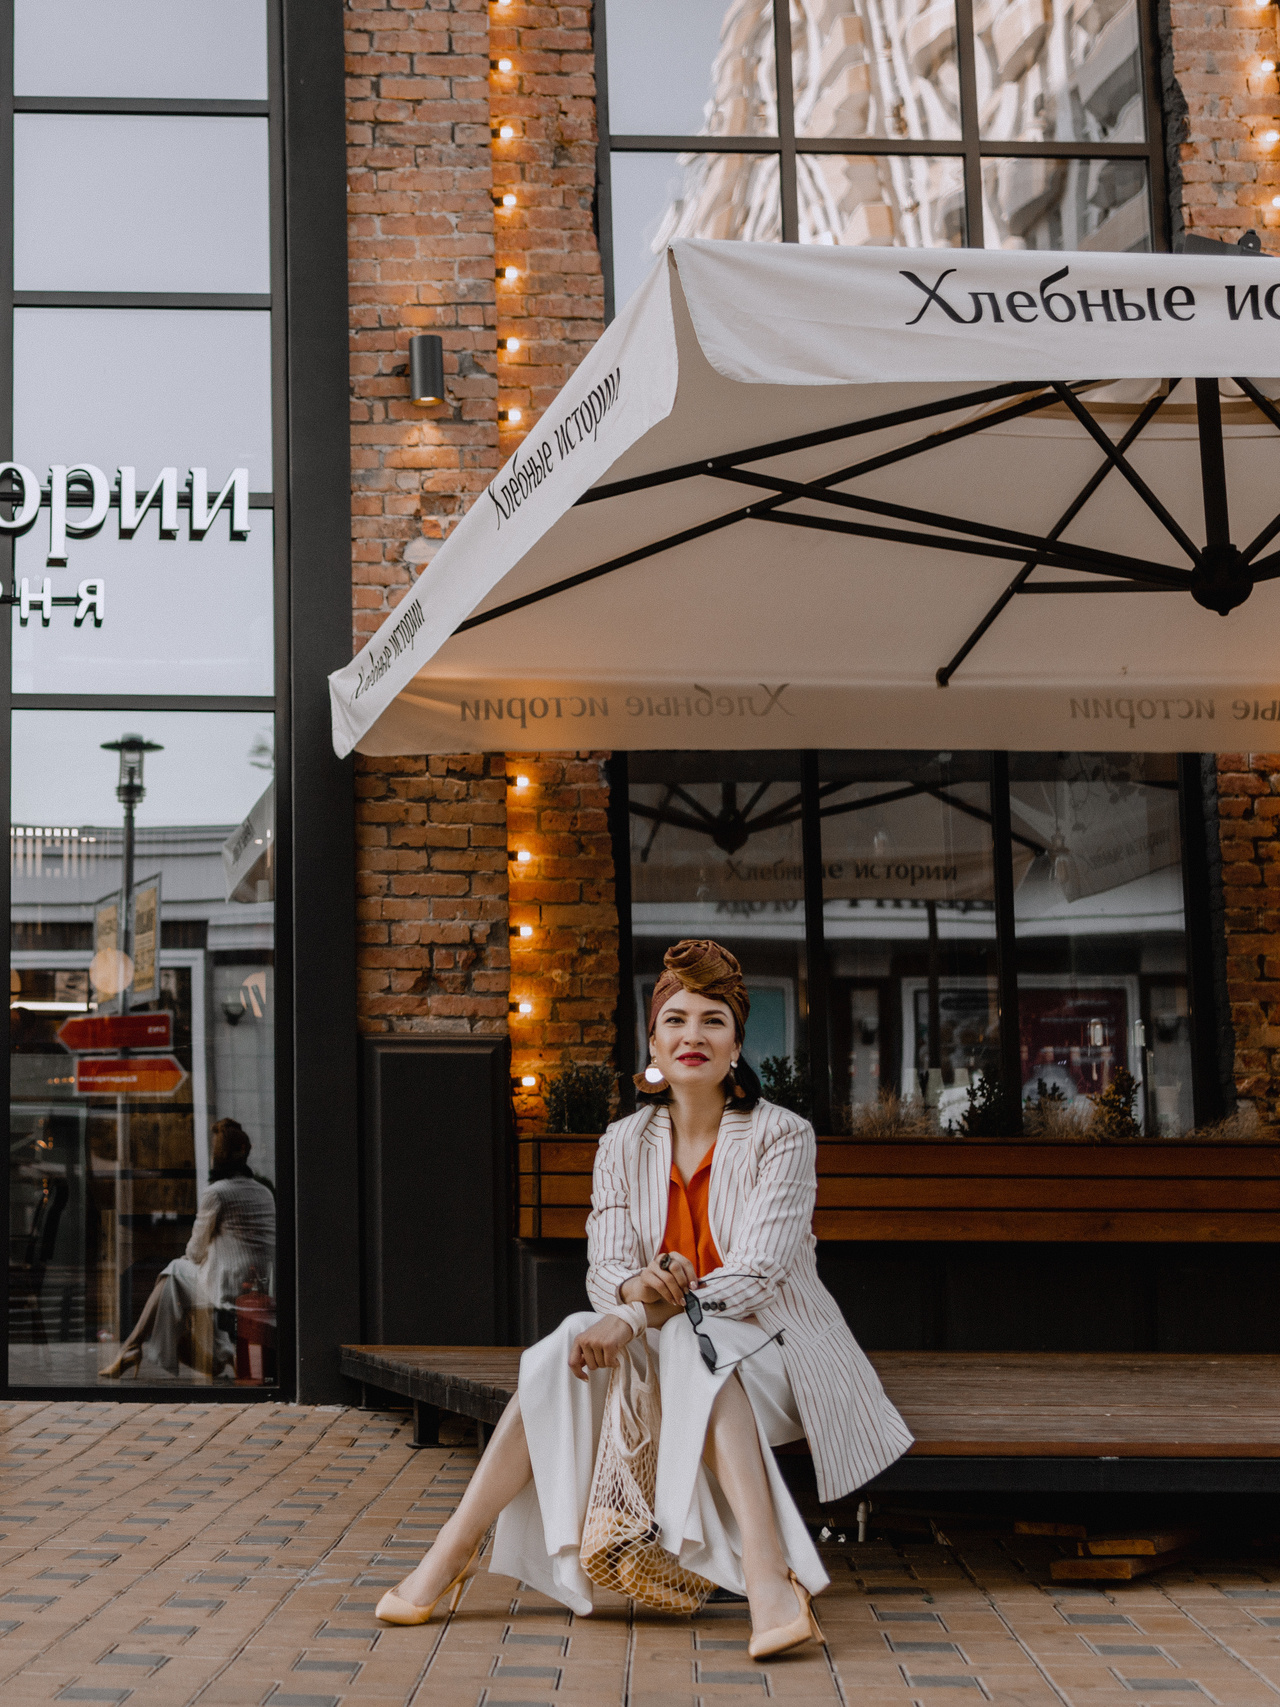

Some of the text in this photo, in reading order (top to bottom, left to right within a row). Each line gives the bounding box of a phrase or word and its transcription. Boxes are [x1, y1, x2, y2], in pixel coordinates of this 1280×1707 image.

[899, 265, 1196, 325] Хлебные
[488, 367, 621, 531] Хлебные истории
